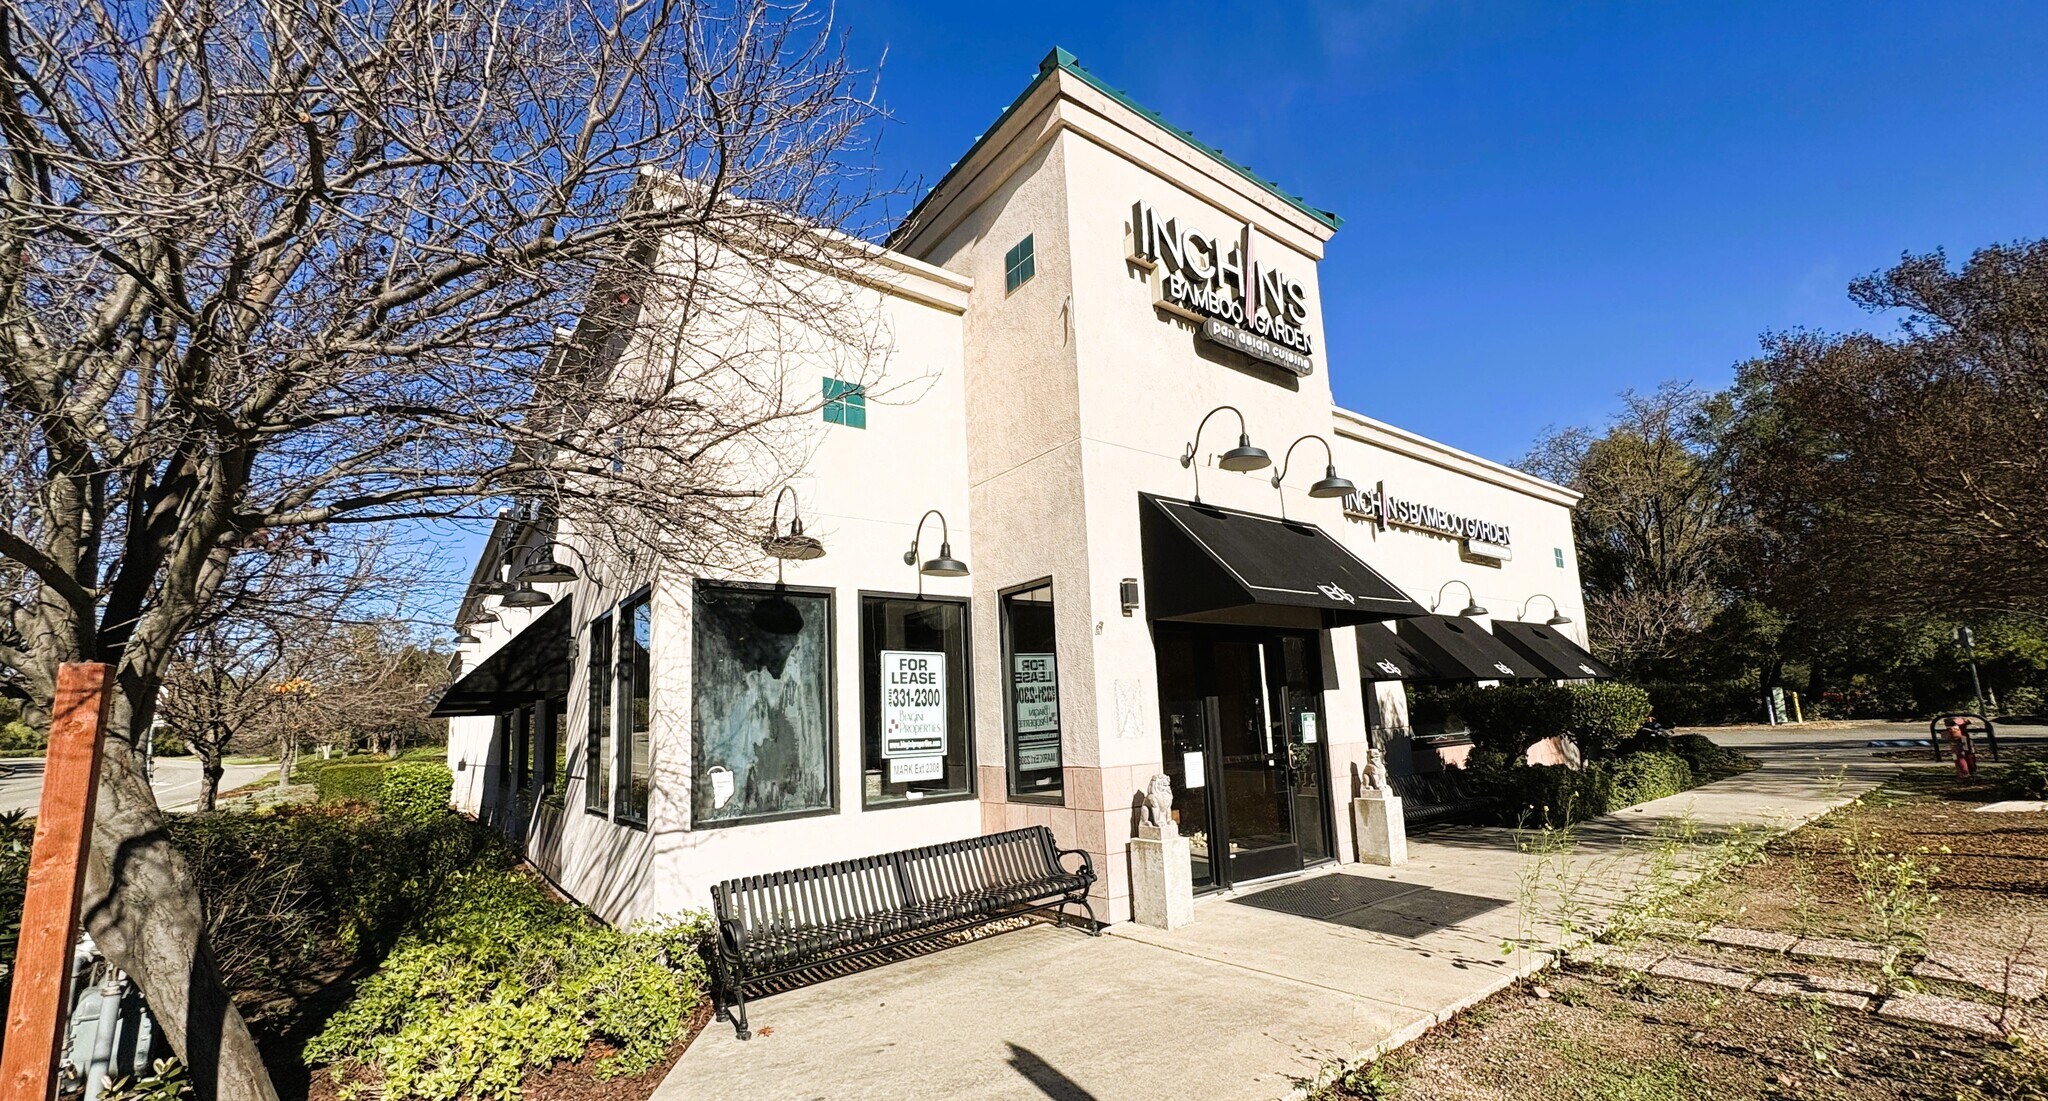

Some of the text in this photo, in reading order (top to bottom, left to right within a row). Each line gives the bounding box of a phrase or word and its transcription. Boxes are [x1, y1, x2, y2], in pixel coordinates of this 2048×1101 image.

[1168, 274, 1314, 353] BAMBOO GARDEN
[1212, 321, 1310, 369] pan asian cuisine
[1410, 503, 1464, 536] BAMBOO
[1466, 518, 1511, 545] GARDEN
[900, 658, 928, 671] FOR
[892, 672, 936, 684] LEASE
[892, 688, 941, 707] 331-2300
[893, 765, 913, 775] MARK
